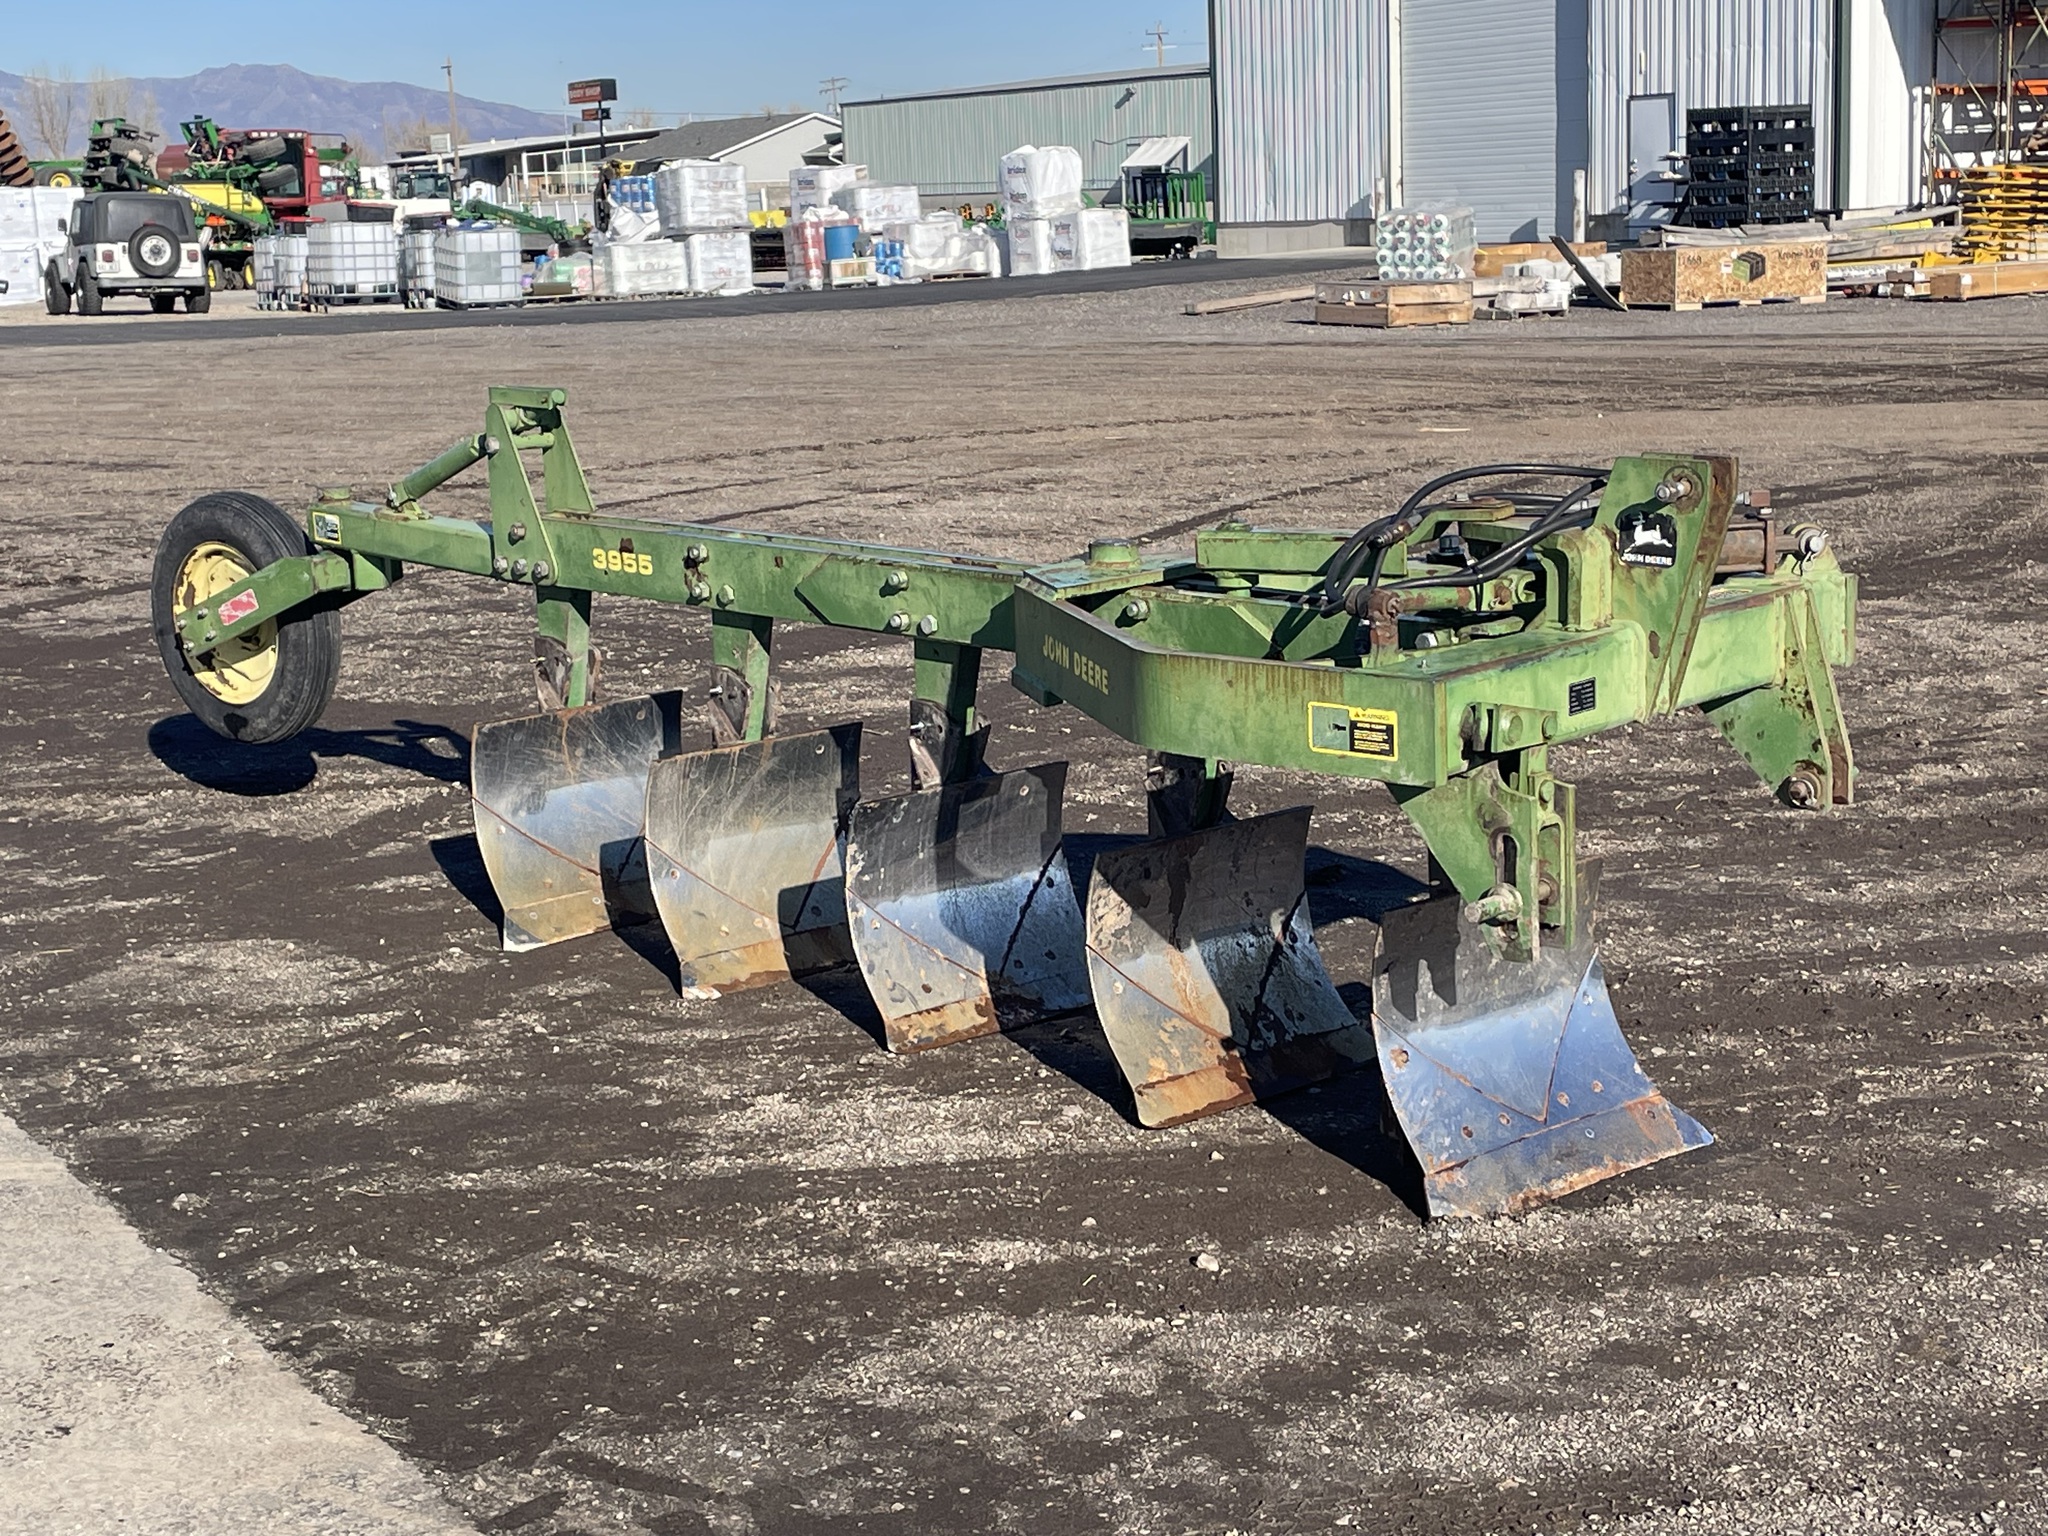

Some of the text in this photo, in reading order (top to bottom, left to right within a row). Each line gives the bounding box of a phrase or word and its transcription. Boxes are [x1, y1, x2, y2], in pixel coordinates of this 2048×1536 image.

[592, 547, 653, 576] 3955
[1621, 553, 1673, 566] JOHN DEERE
[1043, 634, 1109, 695] JOHN DEERE
